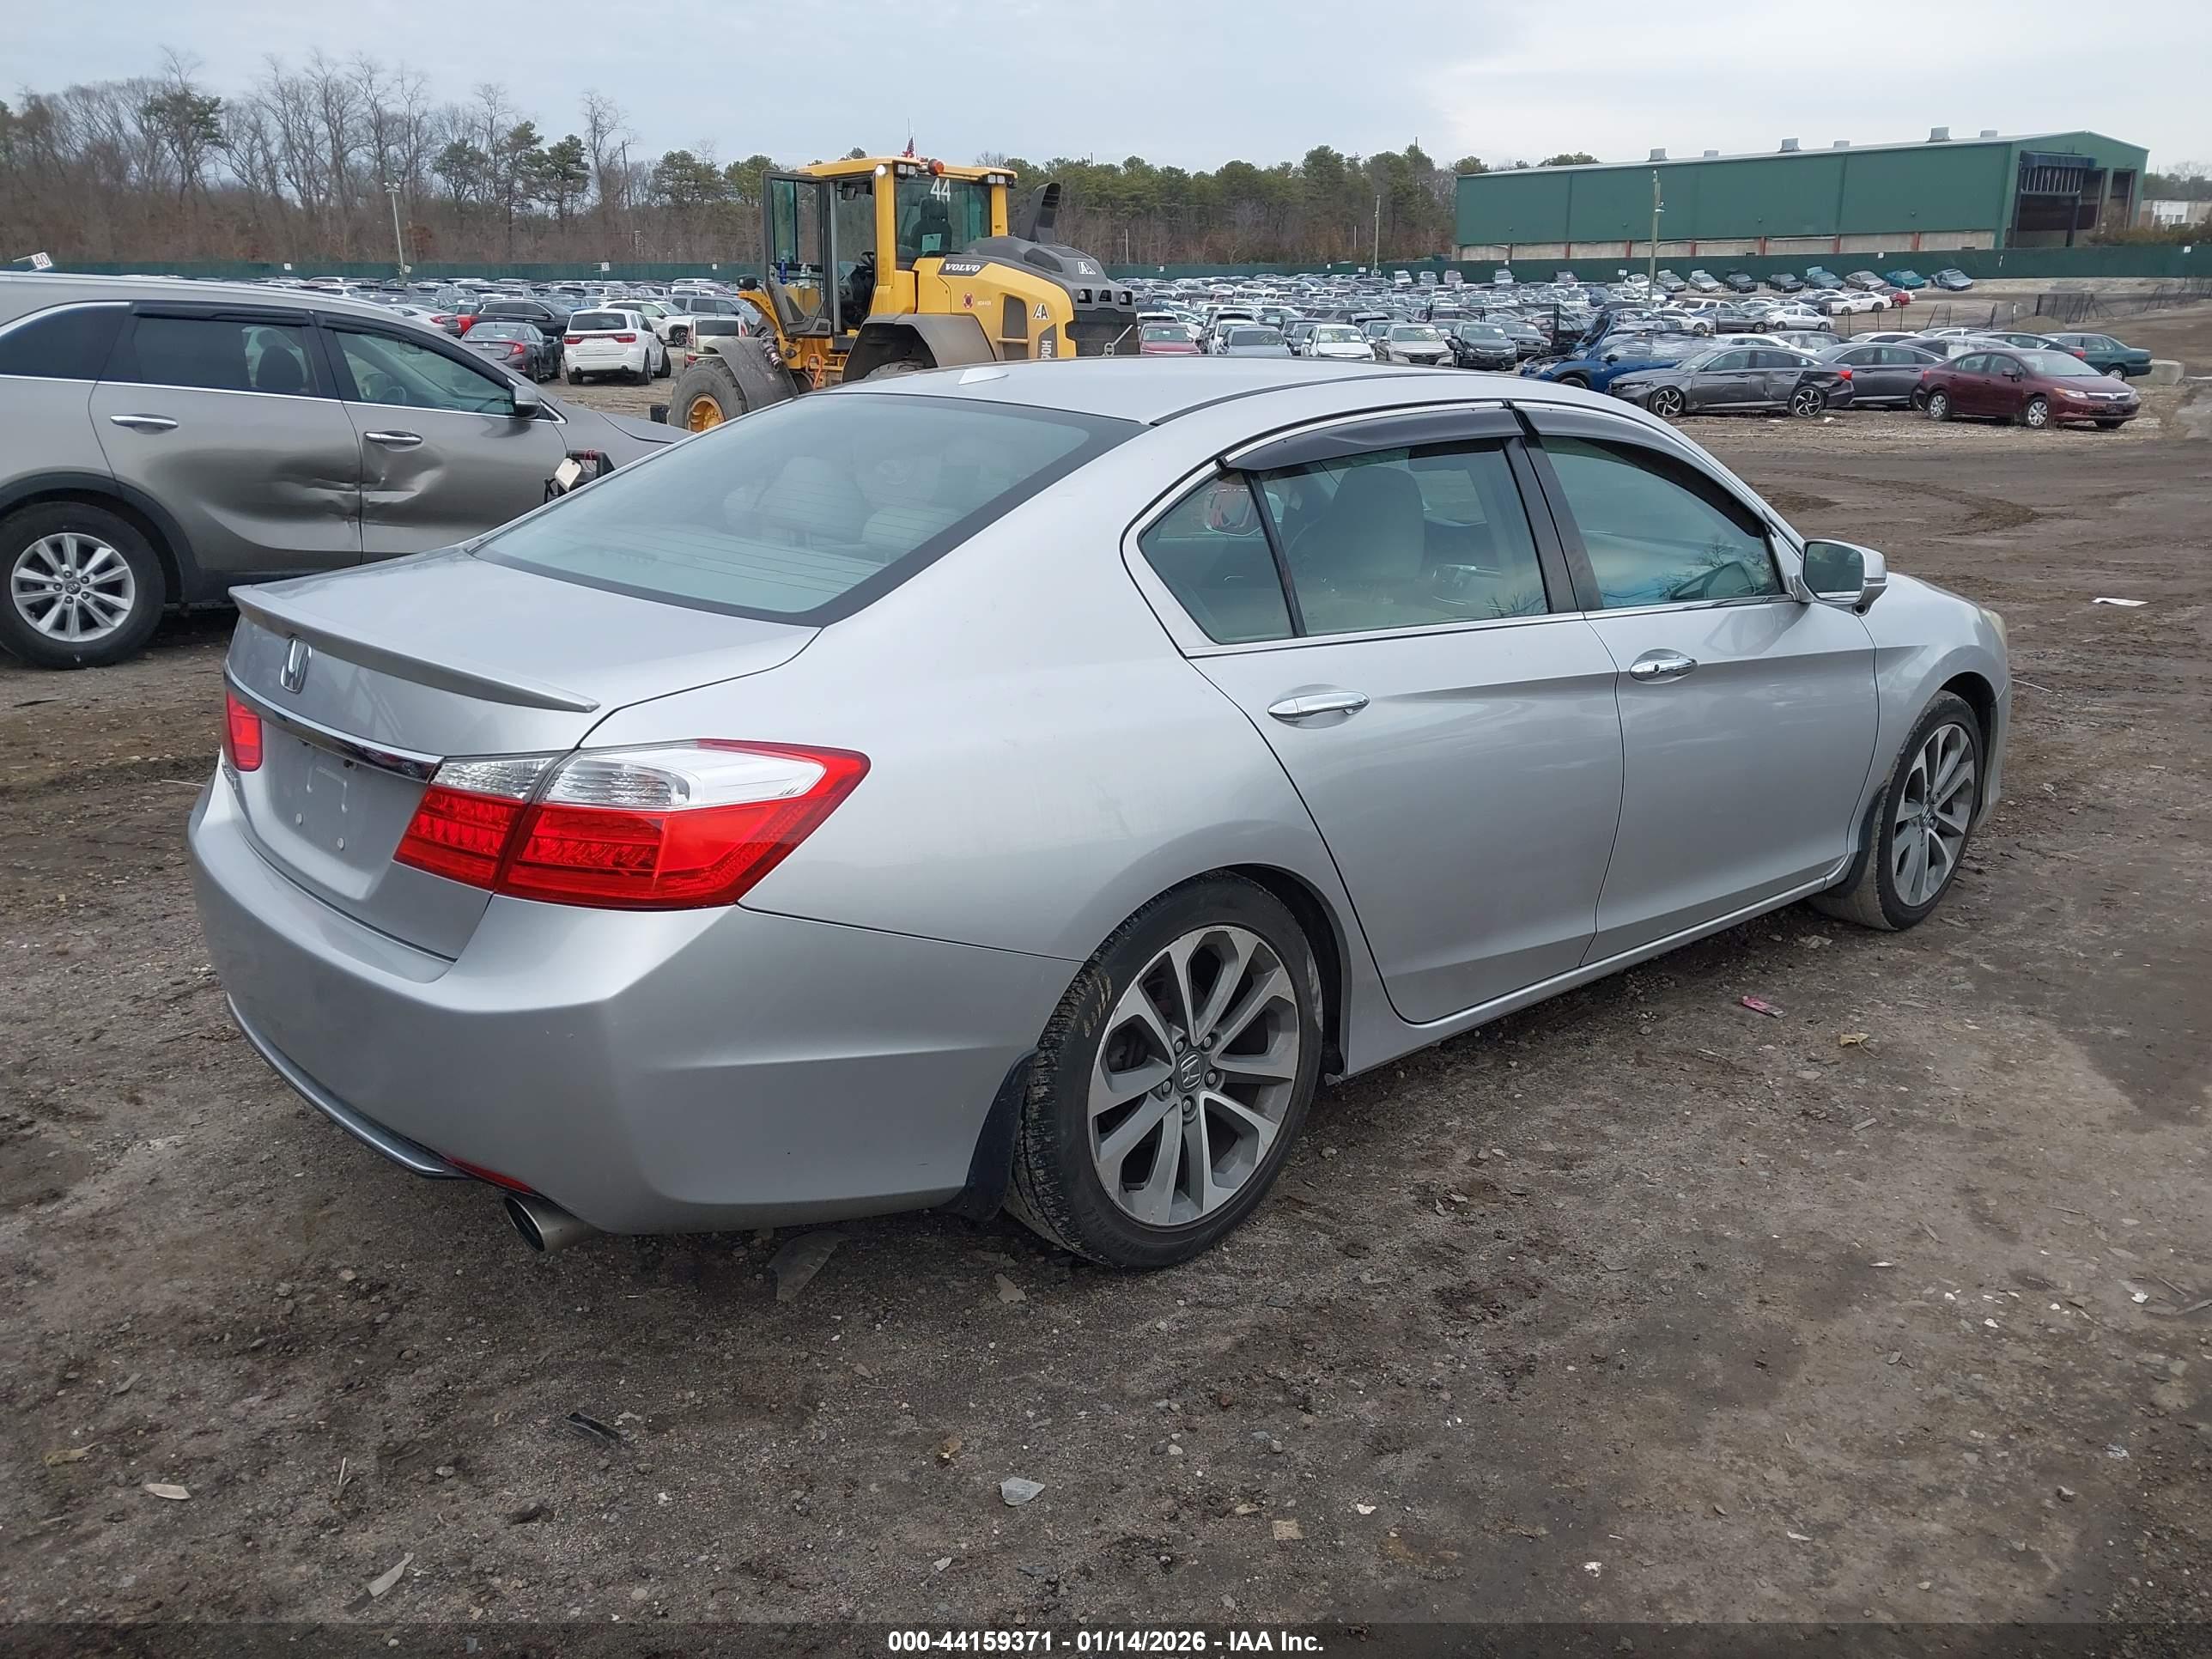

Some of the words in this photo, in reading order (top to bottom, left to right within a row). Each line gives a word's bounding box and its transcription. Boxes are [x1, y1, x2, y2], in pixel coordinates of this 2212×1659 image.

[930, 177, 951, 202] 44
[35, 253, 50, 266] 40
[945, 263, 981, 272] VOLVO
